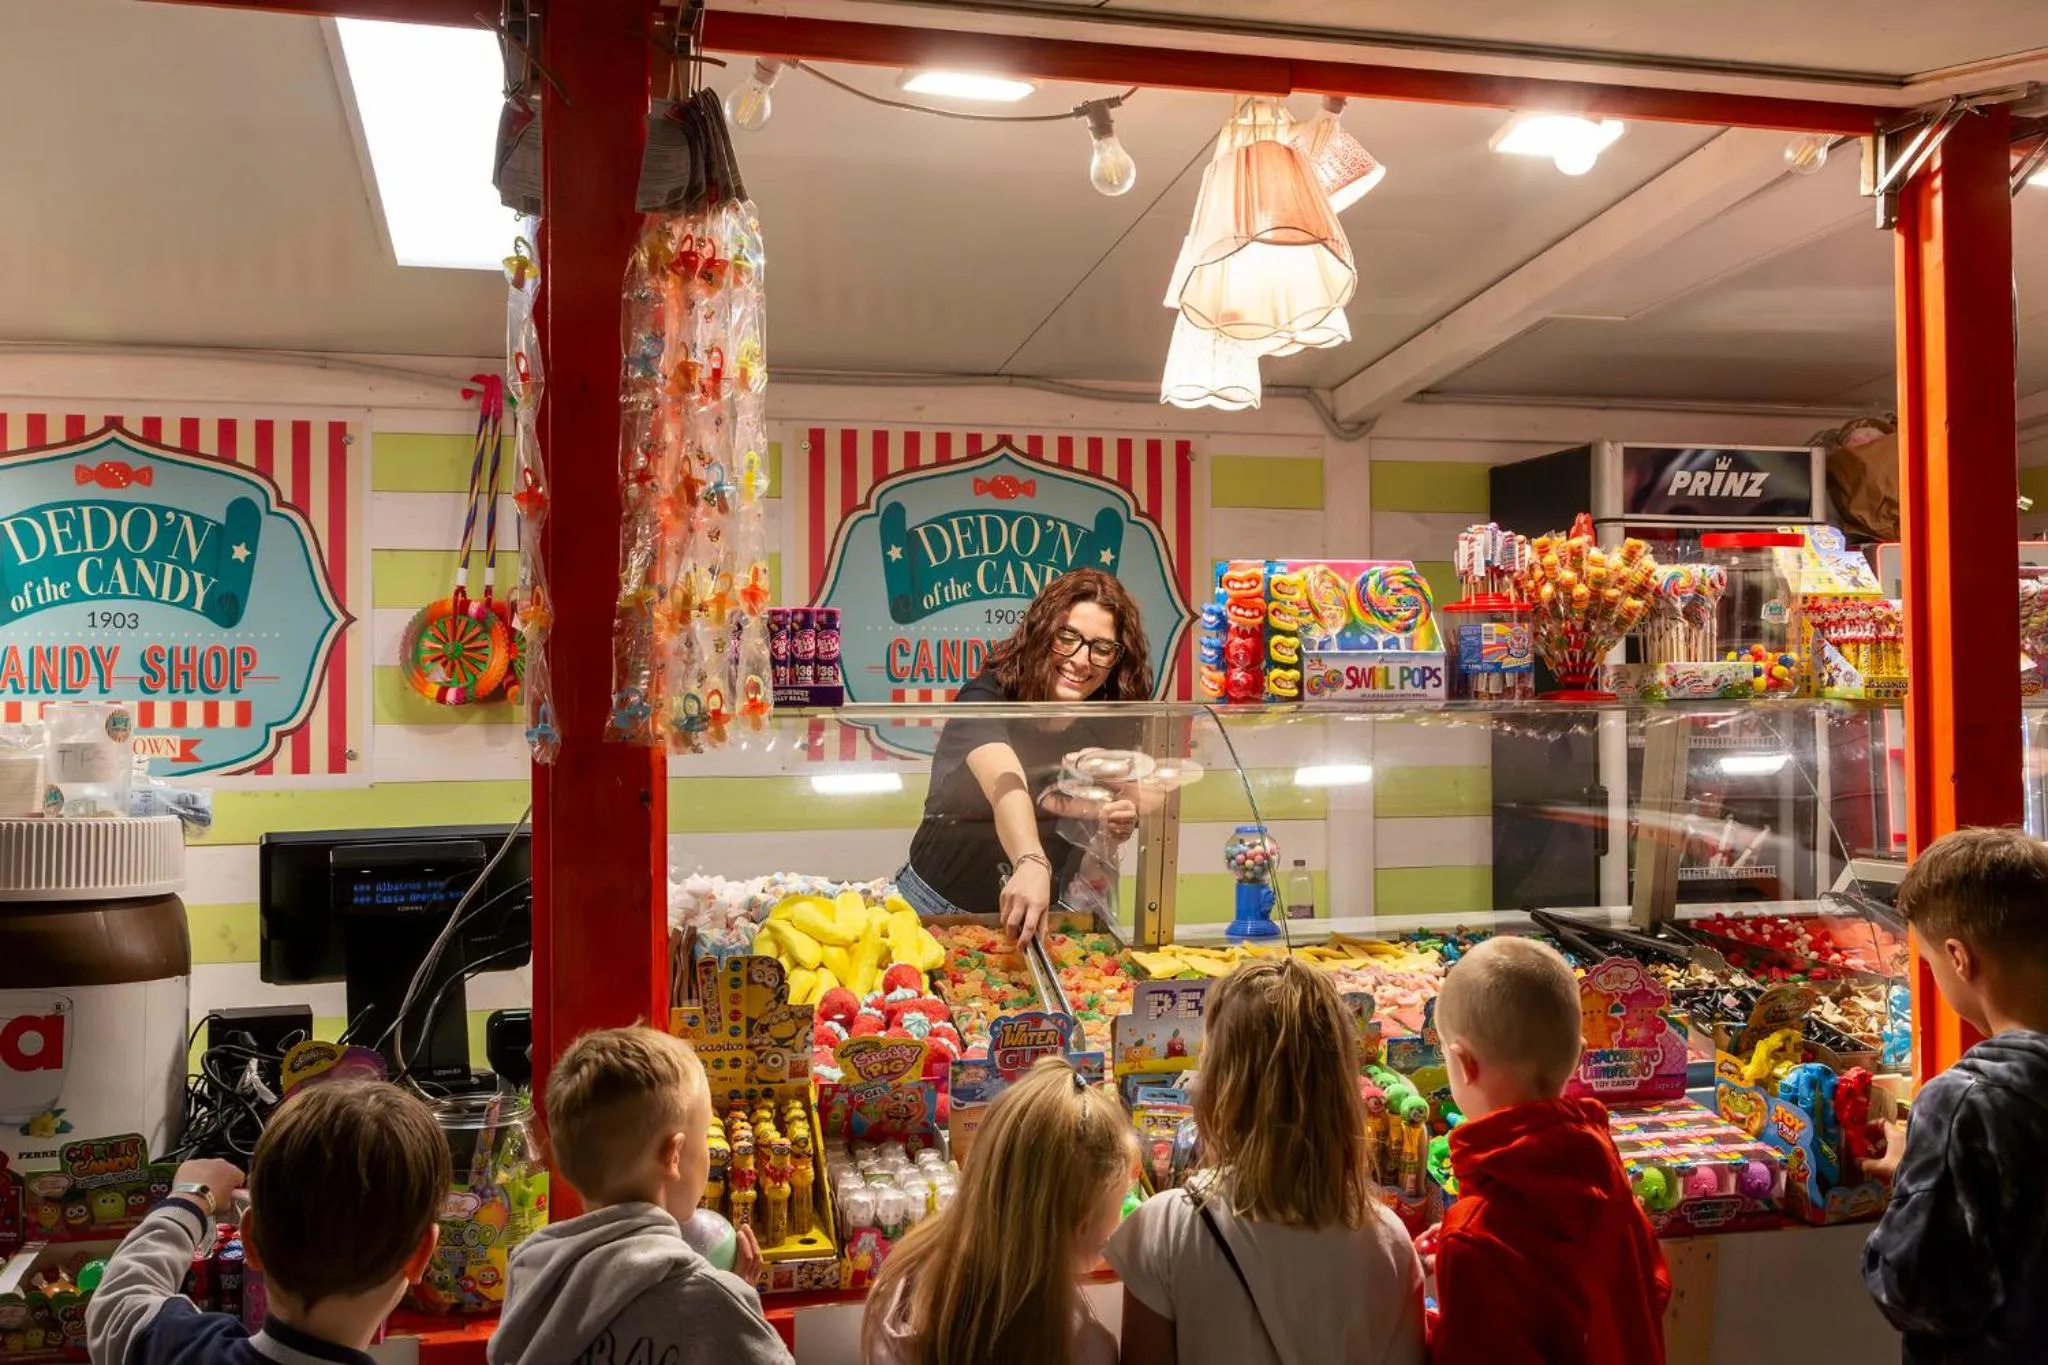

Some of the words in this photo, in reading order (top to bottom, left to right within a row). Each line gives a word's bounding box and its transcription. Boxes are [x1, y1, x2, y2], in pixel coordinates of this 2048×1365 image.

[1667, 470, 1770, 497] PRINZ
[1, 506, 216, 565] DEDO'N
[914, 514, 1088, 567] DEDO'N
[10, 581, 33, 612] of
[36, 577, 71, 605] the
[77, 557, 218, 613] CANDY
[923, 581, 941, 609] of
[944, 577, 972, 602] the
[977, 559, 1063, 598] CAN
[87, 611, 139, 629] 1903
[0, 644, 121, 691] ANDY
[141, 644, 258, 693] SHOP
[1400, 665, 1442, 690] POPS
[133, 738, 178, 756] OWN
[1145, 988, 1205, 1021] PE
[1001, 1022, 1058, 1048] WATER
[1771, 1104, 1805, 1131] TOY
[17, 1150, 58, 1160] FERRE
